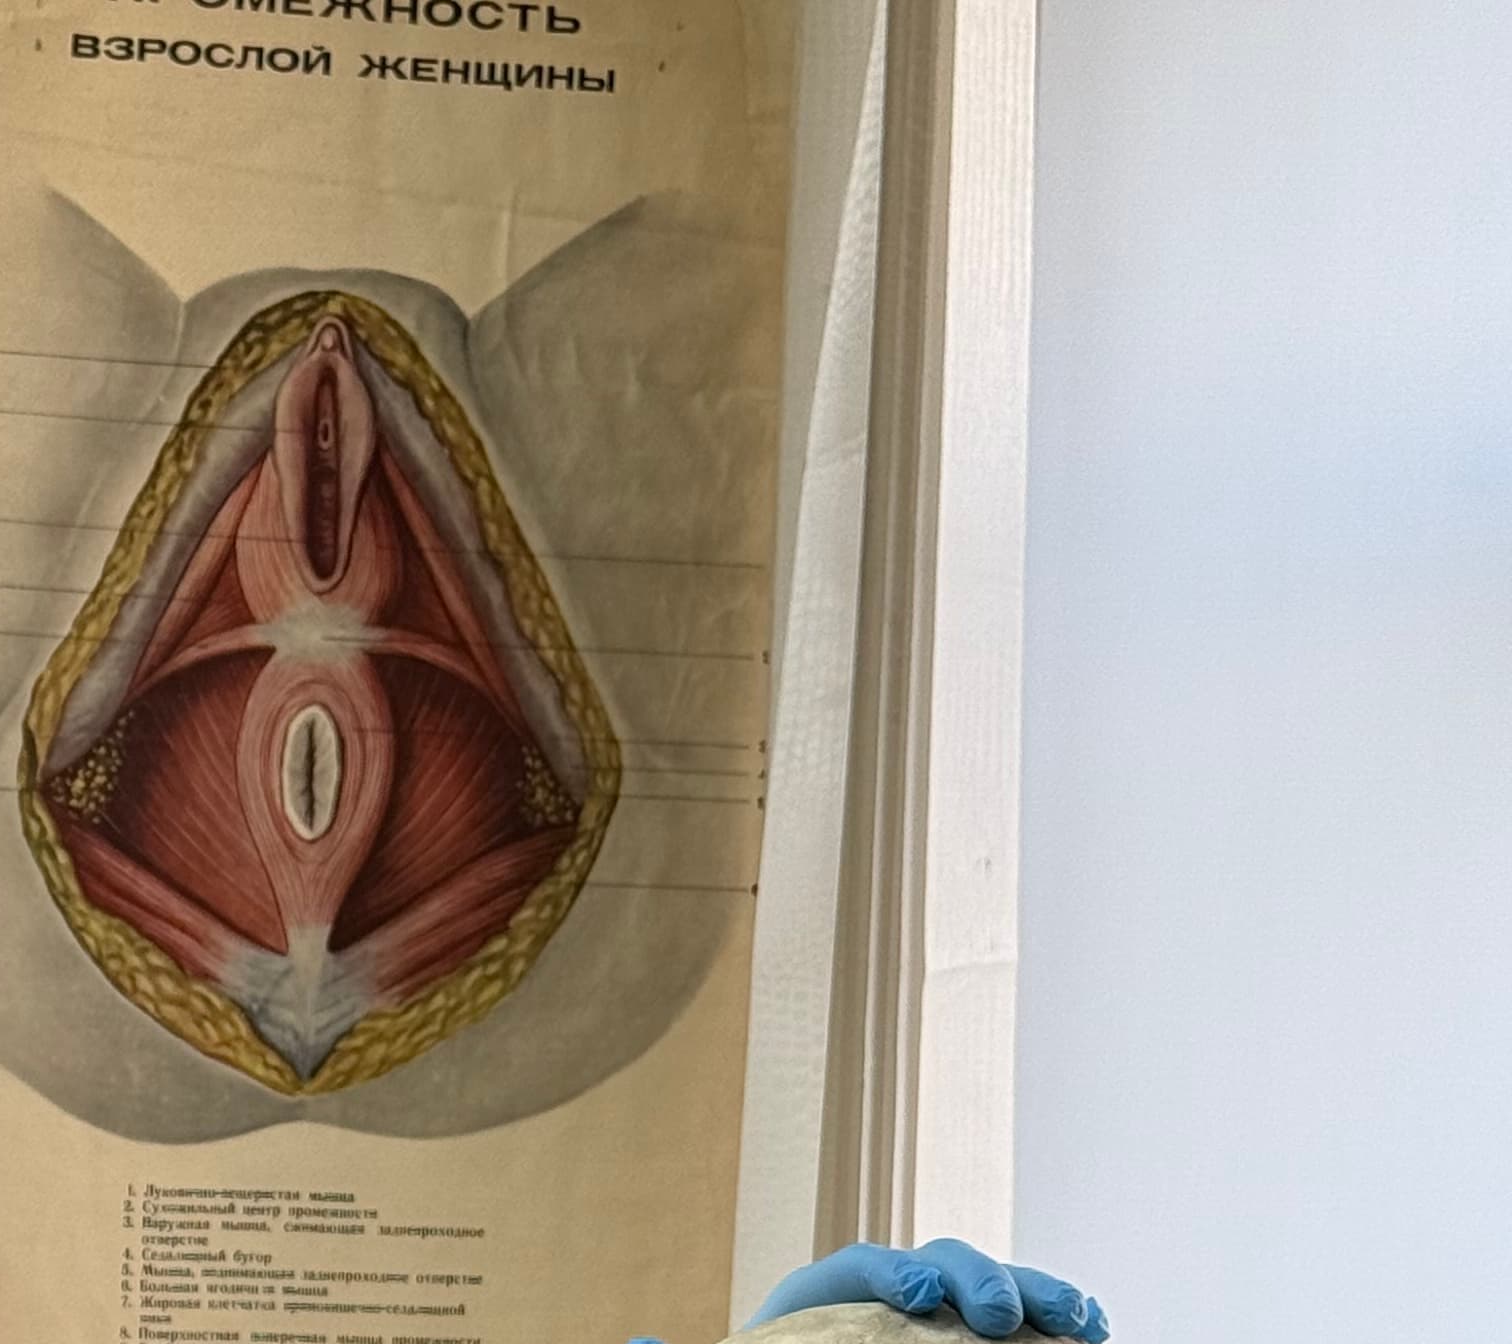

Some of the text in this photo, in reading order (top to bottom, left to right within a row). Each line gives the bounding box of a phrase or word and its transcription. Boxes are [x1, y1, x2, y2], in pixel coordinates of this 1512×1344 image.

[113, 0, 581, 34] ЕЖНОСТЬ
[69, 33, 617, 93] ВЗРОСЛОЙ ЖЕНЩИНЫ
